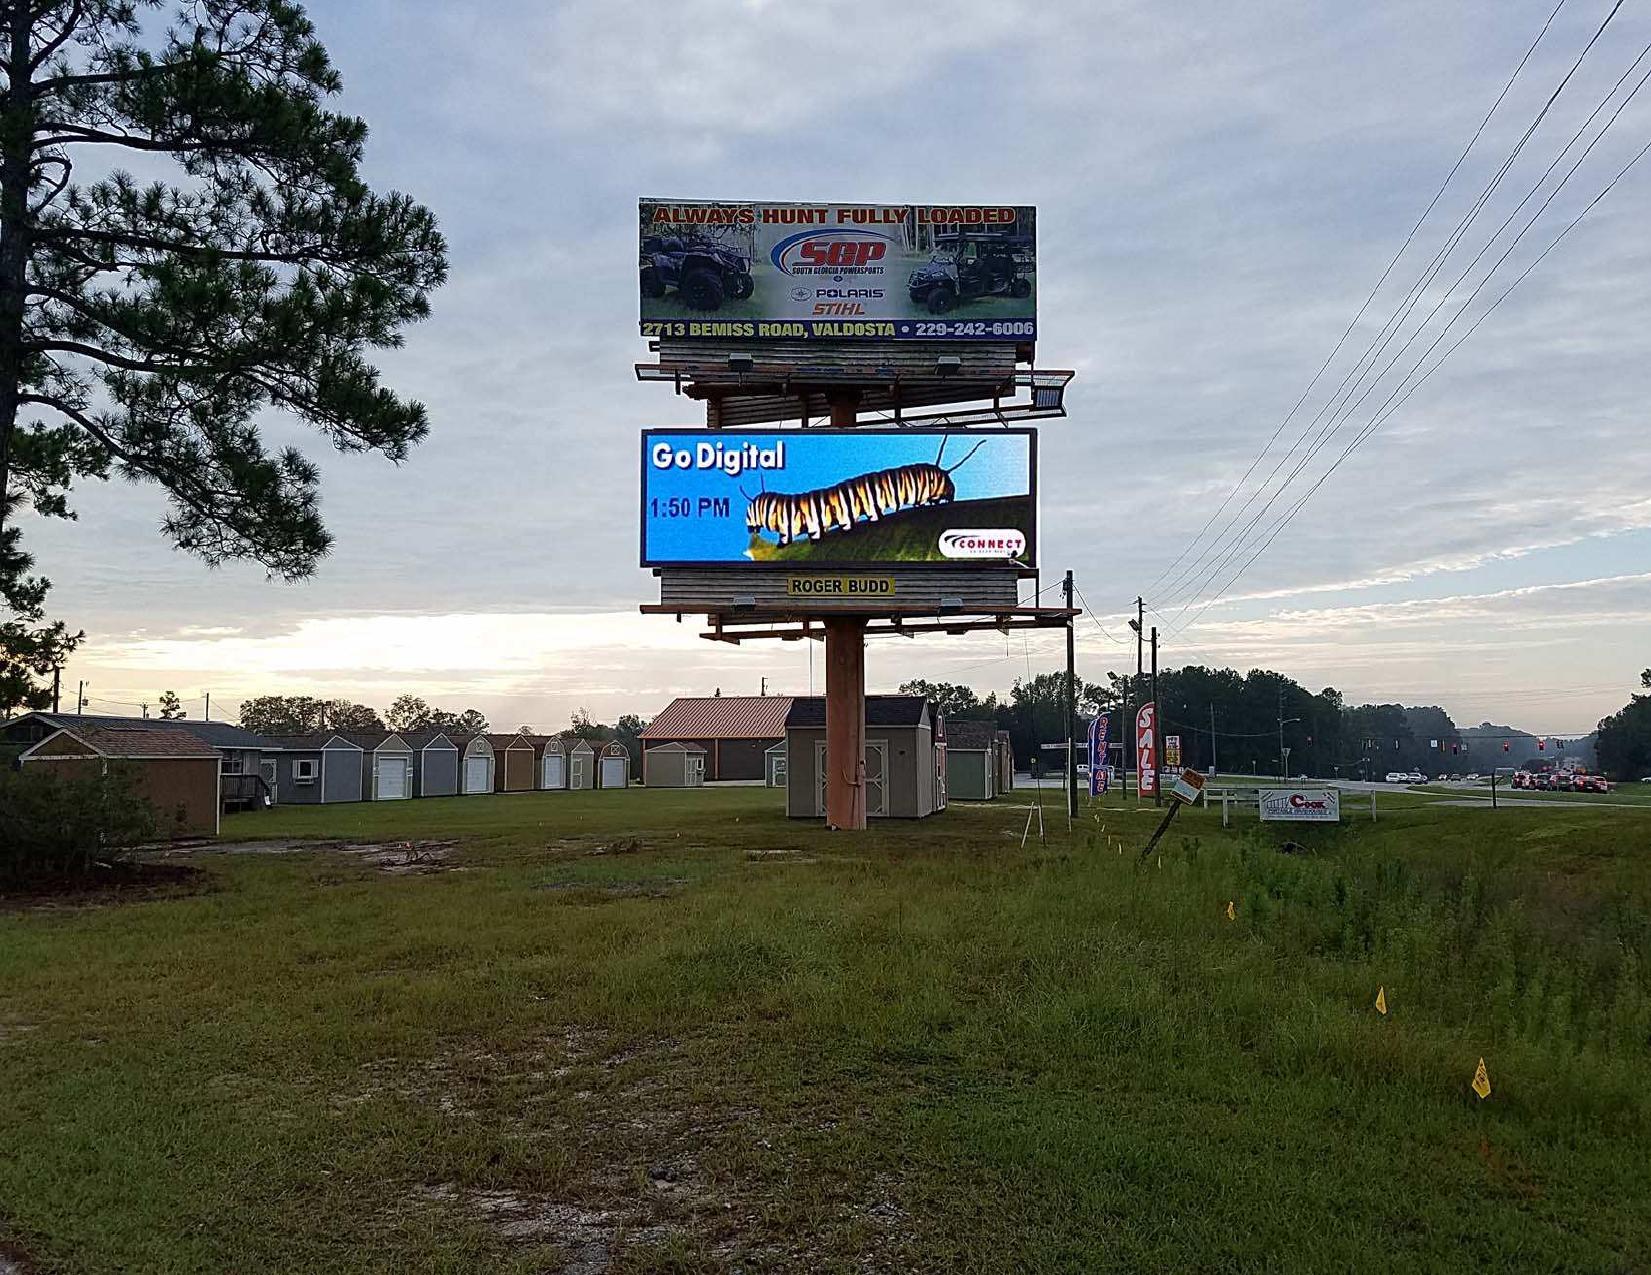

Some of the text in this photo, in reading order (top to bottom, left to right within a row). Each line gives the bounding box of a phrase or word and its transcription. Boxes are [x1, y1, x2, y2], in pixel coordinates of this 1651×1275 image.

[653, 207, 1016, 224] ALWAYS HUNT FULLY LOADED
[791, 242, 887, 266] SGP
[792, 266, 884, 275] SOUTH GEORGIA POWERSPORTS
[816, 289, 884, 298] POLARIS
[812, 303, 865, 315] STIHL
[642, 322, 1034, 338] 2713 BEMISS ROAD, VALDOSTA 229-242-6006
[652, 440, 784, 475] Go Digital
[651, 497, 730, 518] 1:50 PM
[959, 539, 1021, 549] CONNECT
[792, 579, 890, 592] ROGER BUDD
[1139, 708, 1155, 790] SALE
